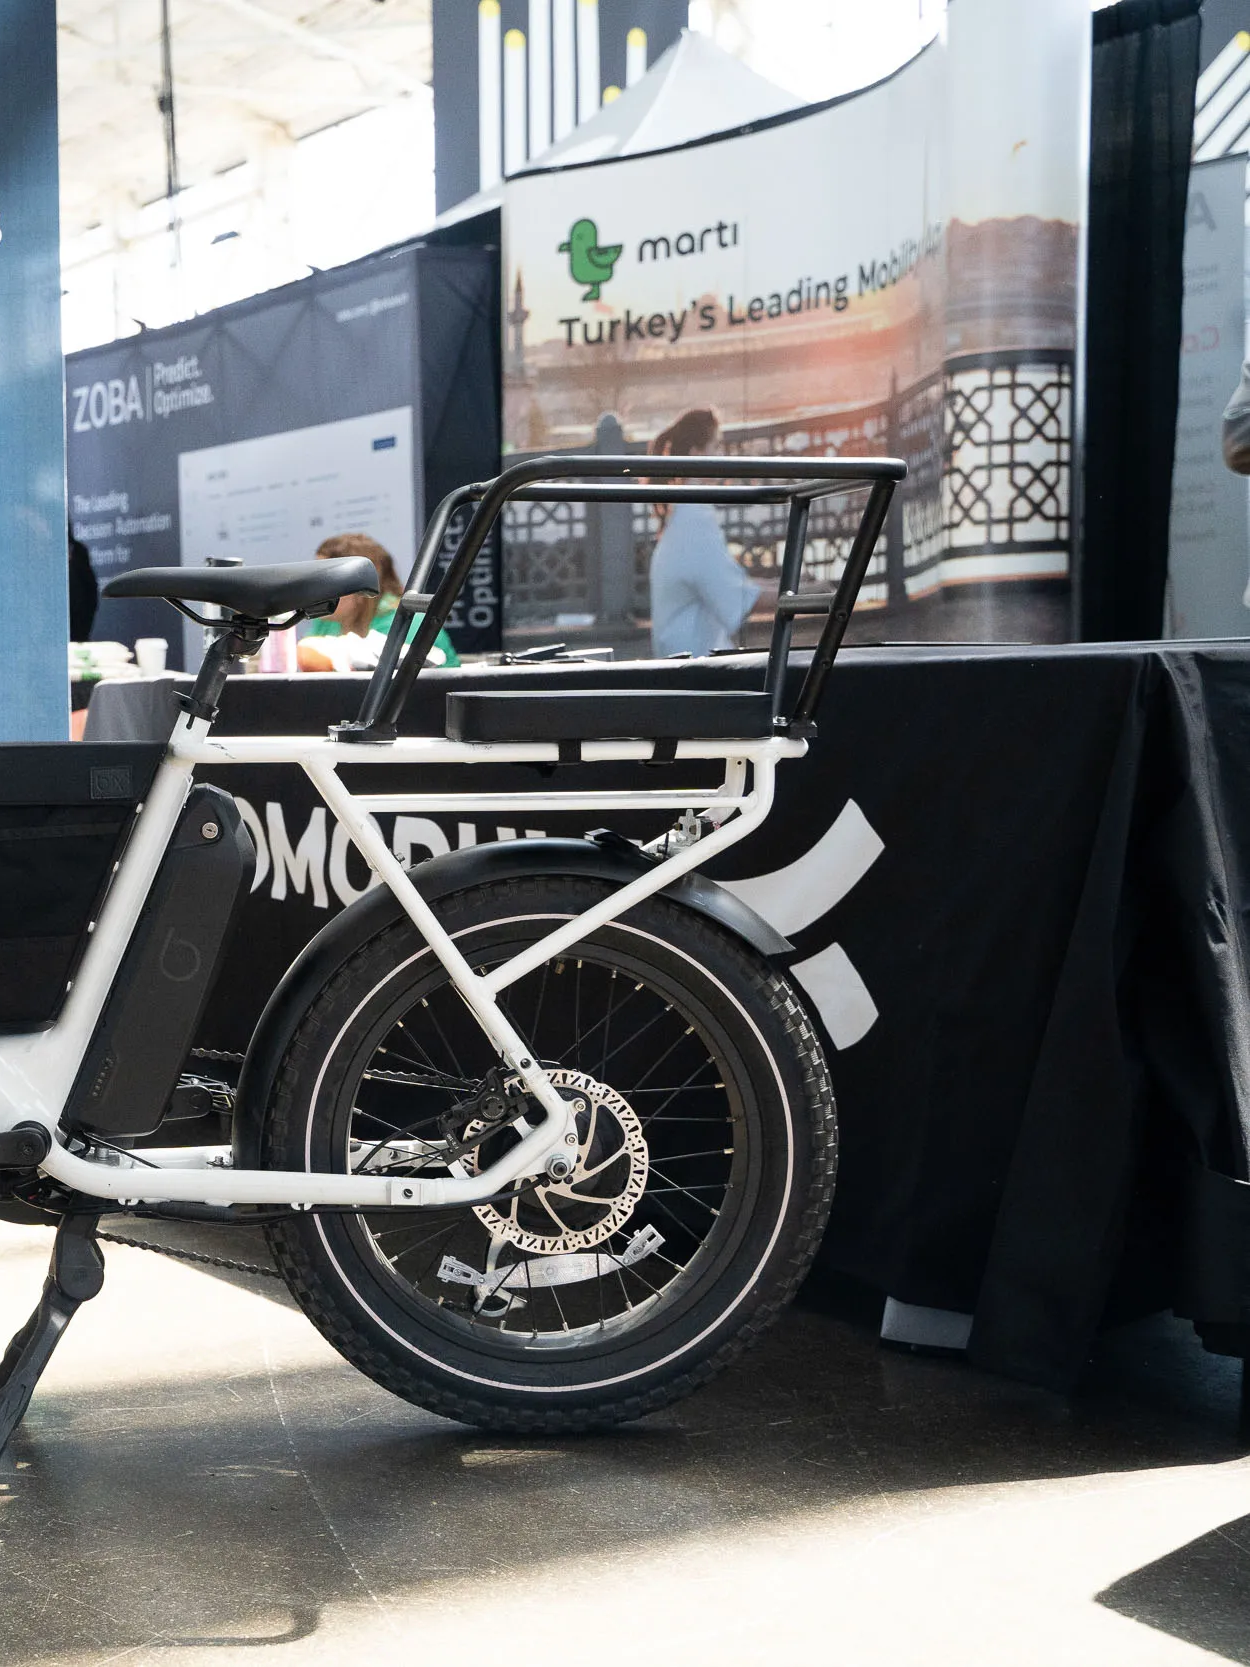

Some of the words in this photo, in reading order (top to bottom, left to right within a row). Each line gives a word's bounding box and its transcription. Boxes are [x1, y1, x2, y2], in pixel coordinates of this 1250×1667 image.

[559, 300, 716, 348] Turkey's
[727, 274, 850, 327] Leading
[71, 374, 144, 433] ZOBA
